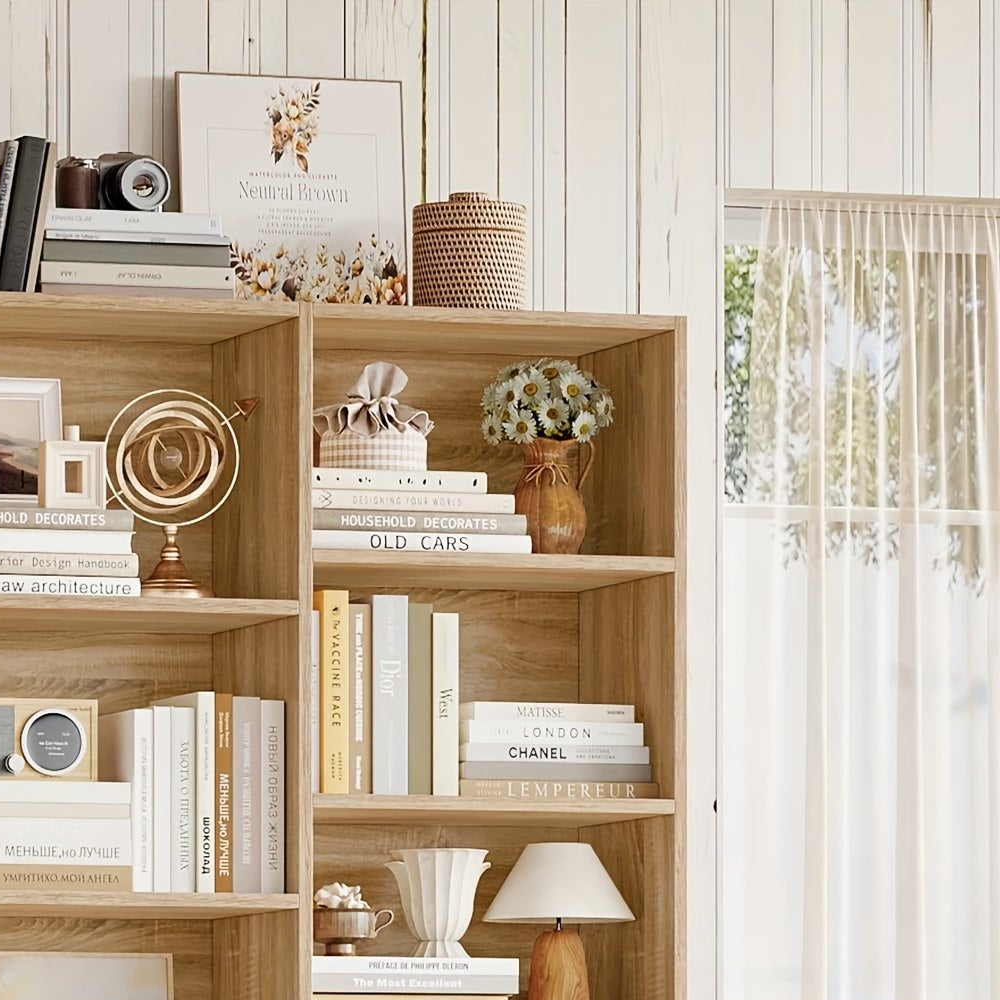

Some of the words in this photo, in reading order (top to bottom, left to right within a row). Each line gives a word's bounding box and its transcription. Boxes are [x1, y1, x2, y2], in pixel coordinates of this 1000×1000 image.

[239, 180, 293, 201] Neutral
[298, 183, 348, 203] Brown
[352, 495, 401, 506] DESIGNING
[35, 512, 106, 526] DECORATES
[340, 514, 416, 528] HOUSEHOLD
[424, 516, 498, 530] DECORATES
[370, 534, 407, 550] OLD
[421, 536, 470, 551] CARS
[32, 557, 71, 570] Design
[77, 558, 130, 569] Handbook
[31, 580, 132, 596] architecture
[331, 633, 341, 689] VACCINE
[380, 659, 401, 696] Dior
[331, 694, 341, 728] RACE
[439, 688, 454, 719] West
[516, 705, 564, 719] MATISSE
[523, 727, 592, 739] LONDON
[267, 725, 279, 773] НОВЫЙ
[508, 746, 567, 760] CHANEL
[267, 776, 279, 818] ОБРАЗ
[507, 782, 636, 799] LEMPEREUR
[202, 816, 211, 875] ШОКОЛАД
[267, 822, 279, 871] ЖИЗНИ
[353, 978, 374, 989] The
[376, 978, 405, 989] Most
[409, 978, 463, 989] Excellent
